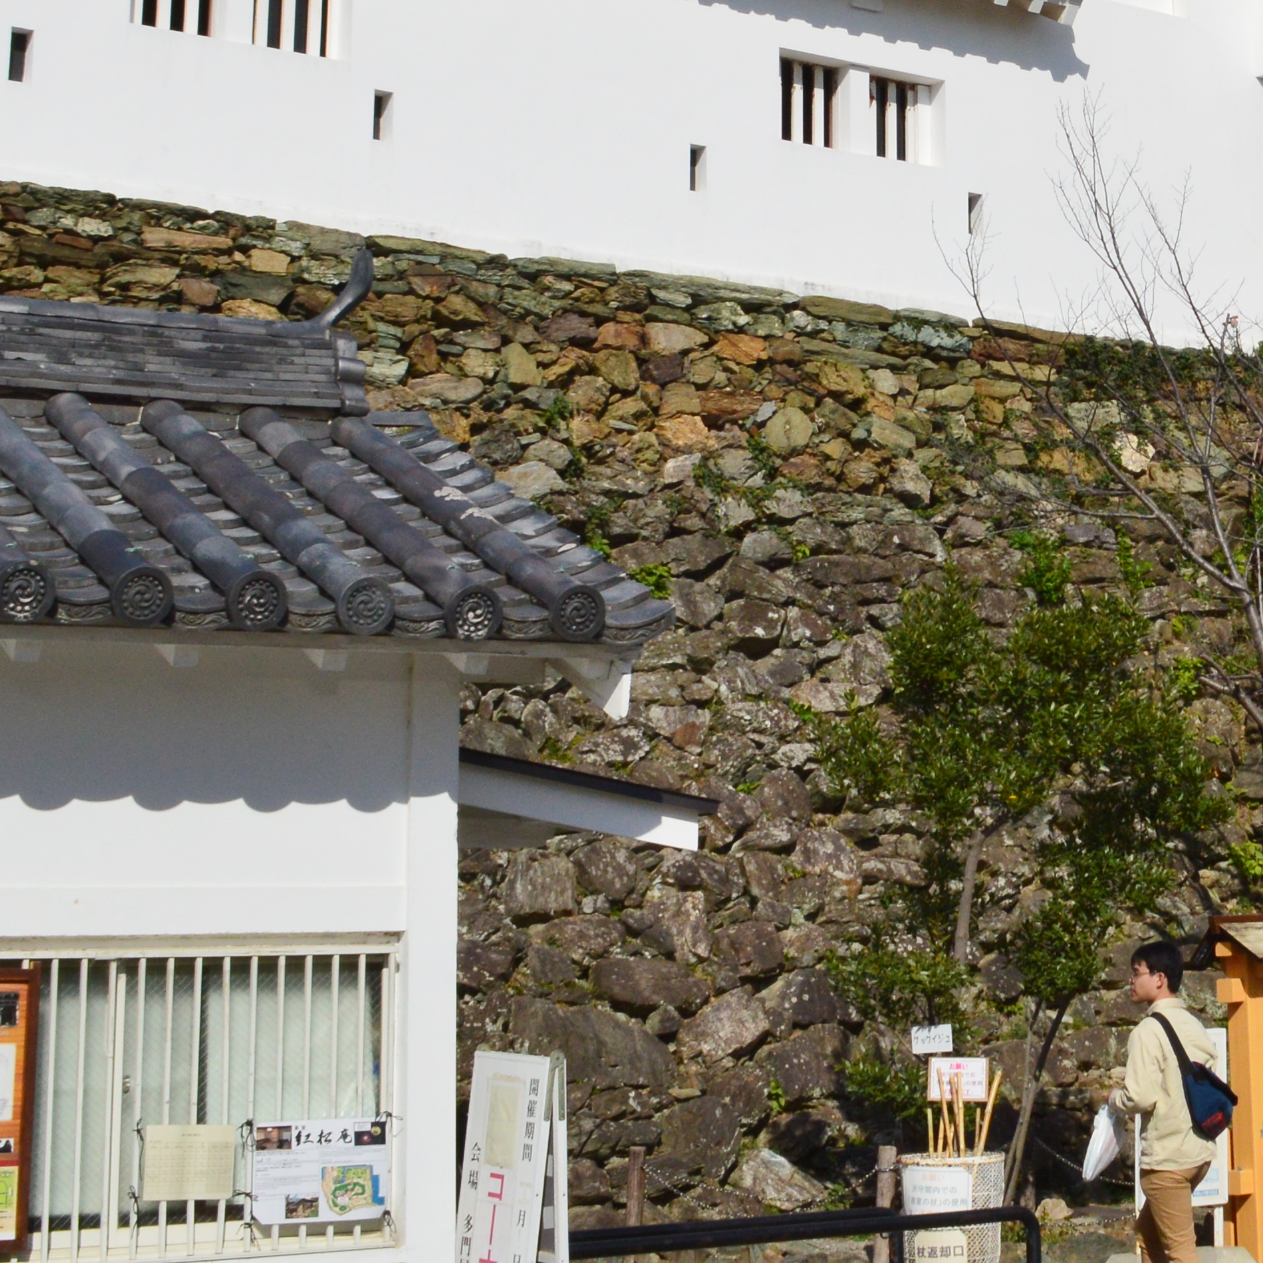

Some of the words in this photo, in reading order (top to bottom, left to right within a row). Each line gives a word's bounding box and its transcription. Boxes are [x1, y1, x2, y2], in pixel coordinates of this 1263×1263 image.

[521, 1078, 540, 1163] 開催期間
[468, 1142, 482, 1191] 会場
[916, 1245, 964, 1259] 杖返却口
